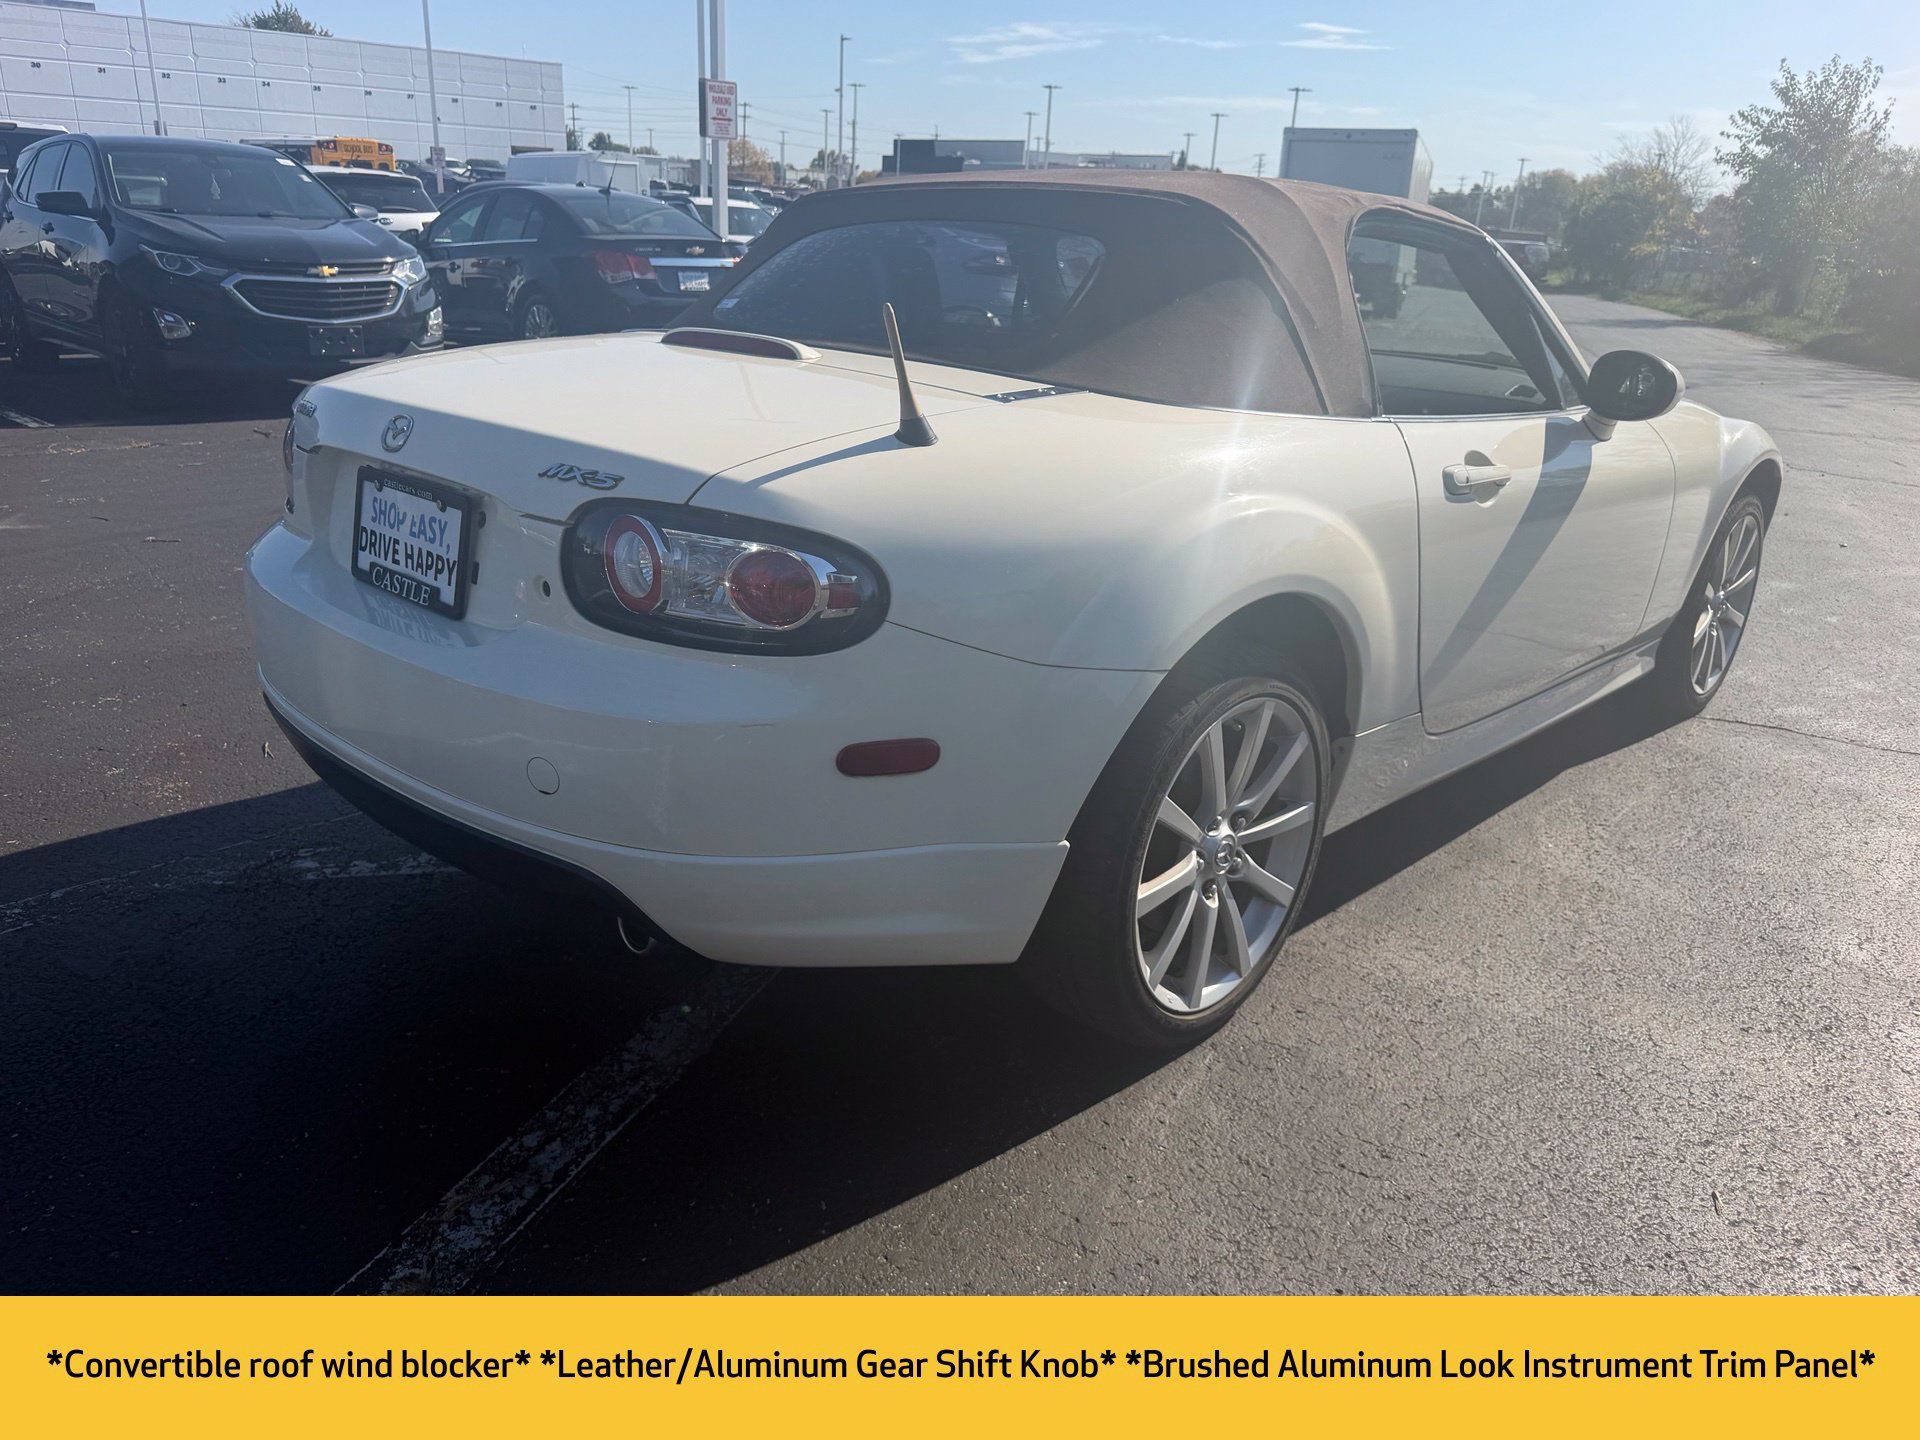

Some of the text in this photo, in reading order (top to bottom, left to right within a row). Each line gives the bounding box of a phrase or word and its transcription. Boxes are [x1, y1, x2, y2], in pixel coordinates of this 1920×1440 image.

[343, 144, 373, 153] SCHOOL BUS
[537, 462, 625, 491] MX-5
[371, 496, 451, 555] SHOP EASY,
[359, 525, 458, 587] DRIVE HAPPY
[372, 566, 432, 606] CASTLE
